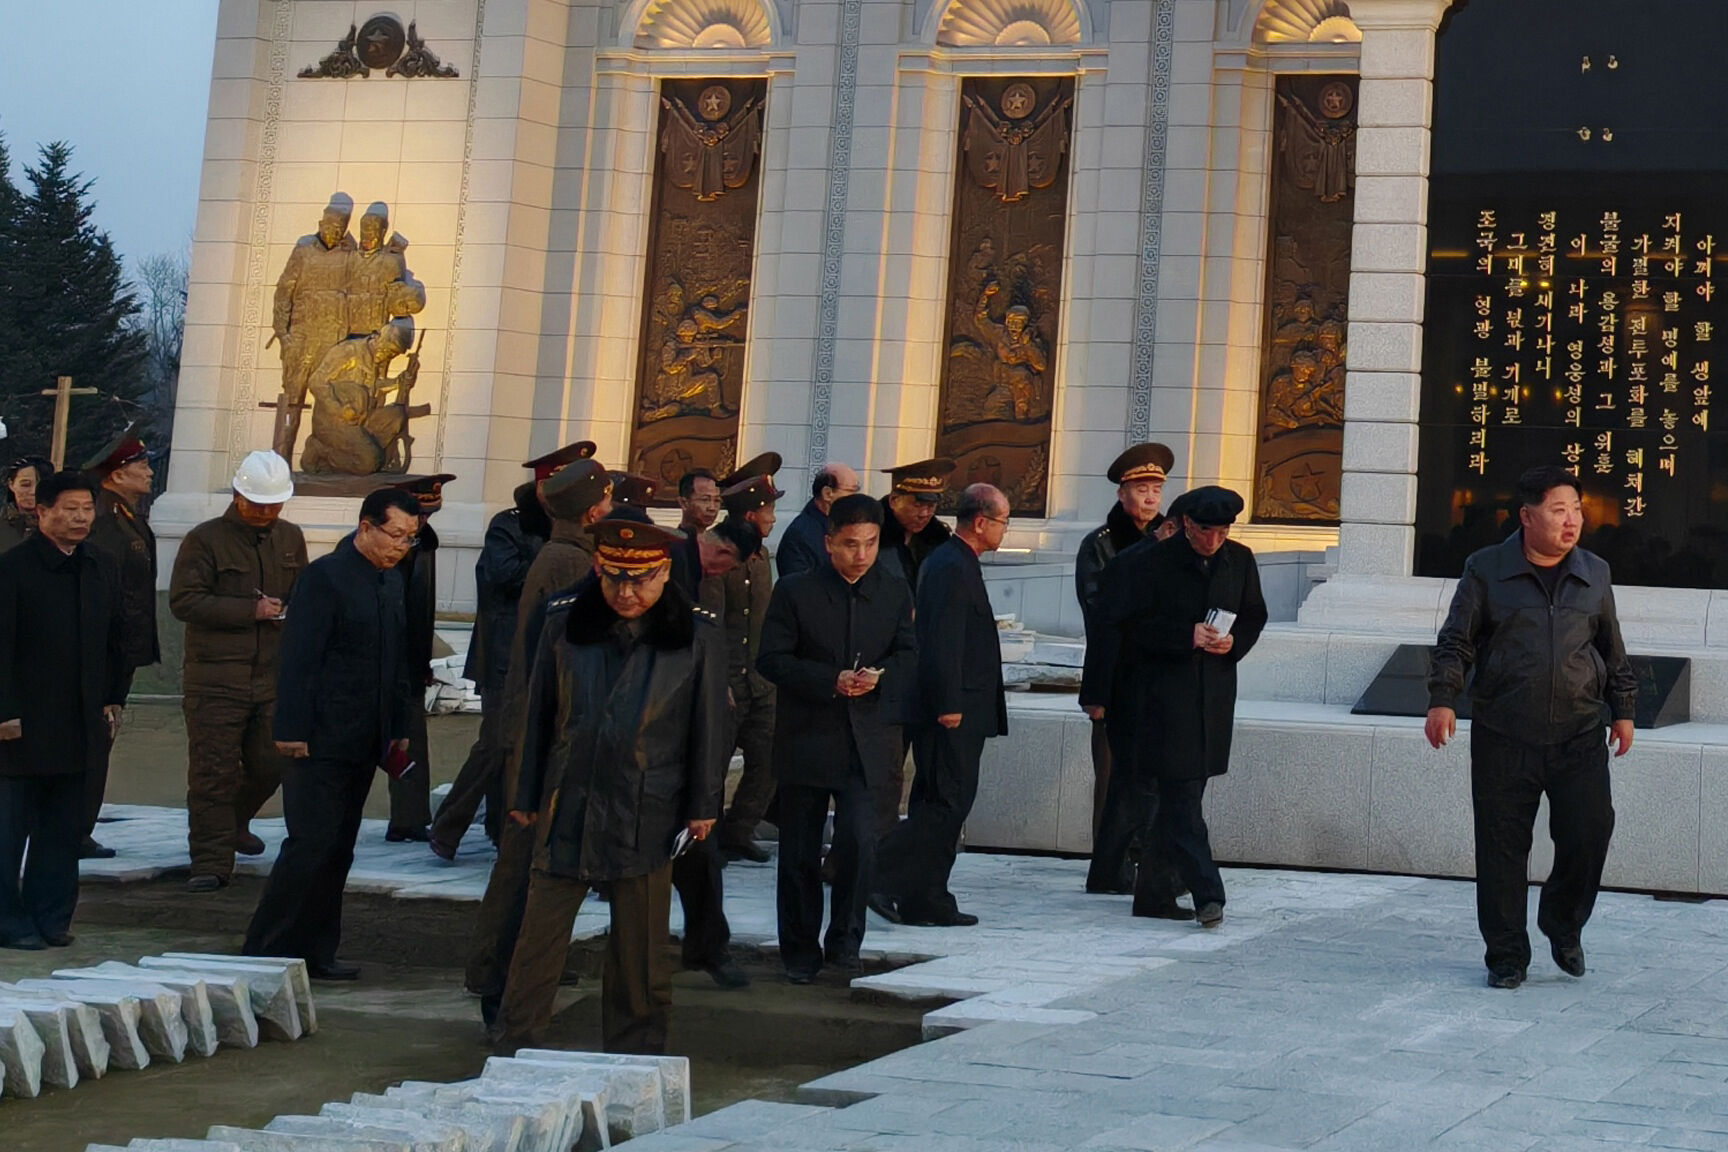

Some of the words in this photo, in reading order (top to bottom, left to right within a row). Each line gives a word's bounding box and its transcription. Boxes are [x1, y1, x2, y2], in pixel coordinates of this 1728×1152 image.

[1476, 210, 1498, 275] 조국의
[1537, 211, 1556, 276] 경건히
[1570, 233, 1587, 256] 이
[1599, 211, 1622, 277] 불굴의
[1662, 212, 1684, 278] 지켜야
[1473, 295, 1494, 339] 영광
[1568, 278, 1589, 324] 나라
[1662, 291, 1682, 312] 할
[1694, 321, 1713, 342] 할
[1534, 290, 1556, 380] 새기나니
[1597, 291, 1619, 380] 용감성과
[1659, 327, 1680, 393] 명예를
[1501, 362, 1522, 424] 기개로
[1595, 393, 1616, 410] 그
[1626, 316, 1649, 428] 전투포화를
[1468, 357, 1492, 475] 불멸하리라
[1658, 408, 1679, 477] 놓으며
[1593, 430, 1614, 474] 위훈
